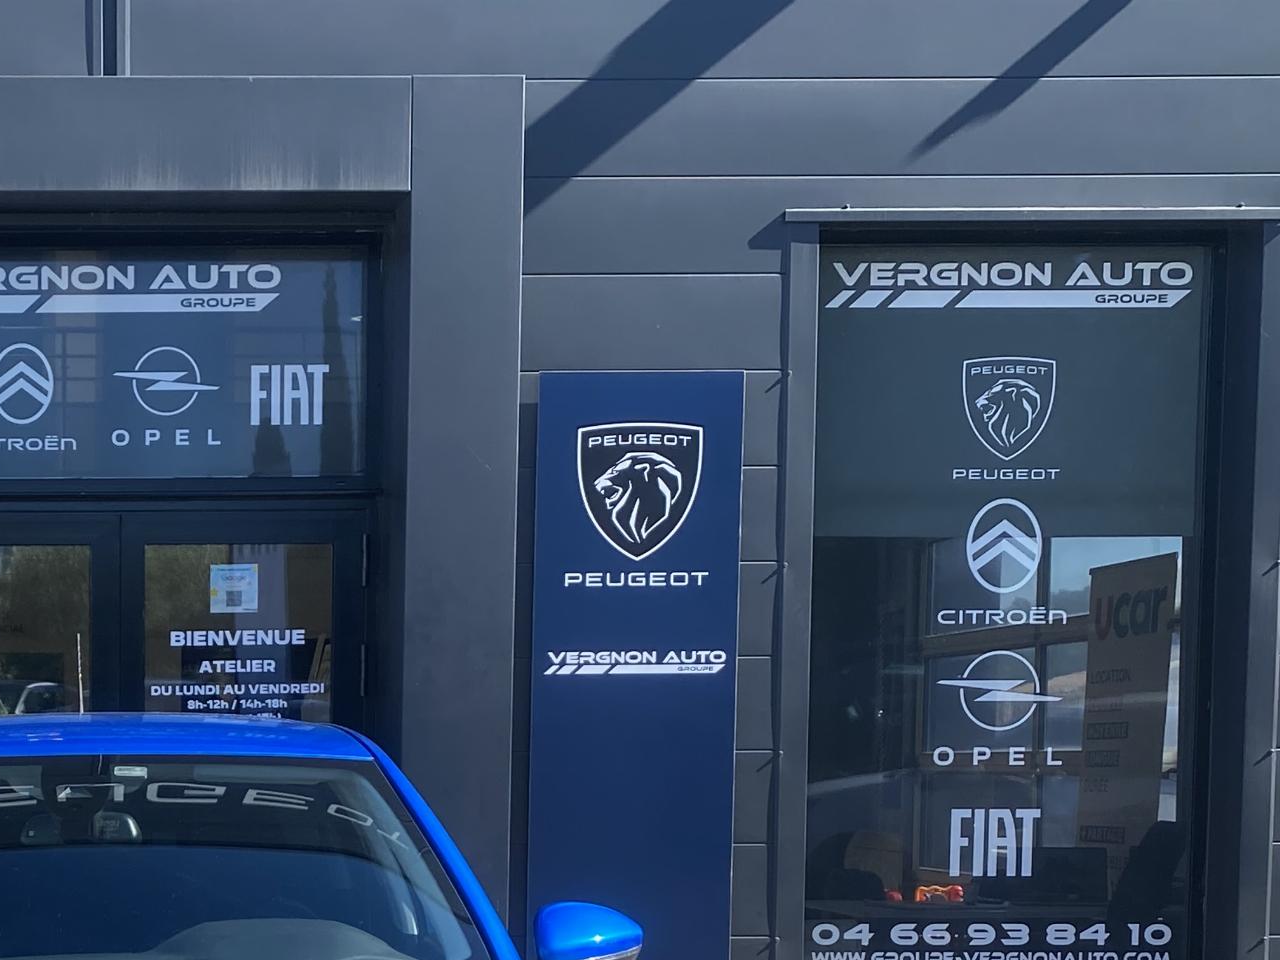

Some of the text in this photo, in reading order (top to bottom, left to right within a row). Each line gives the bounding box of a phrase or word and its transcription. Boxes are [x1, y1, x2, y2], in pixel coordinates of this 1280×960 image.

[149, 264, 282, 290] AUTO
[832, 262, 1194, 286] VERGNON AUTO
[180, 297, 257, 309] GROUPE
[1094, 293, 1169, 304] GROUPE
[970, 365, 1048, 376] PEUGEOT
[250, 363, 330, 426] FIAT
[111, 428, 222, 447] OPEL
[588, 434, 692, 448] PEUGEOT
[952, 469, 1061, 480] PEUGEOT
[564, 571, 709, 587] PEUGEOT
[937, 606, 1067, 625] CITROËN
[170, 629, 306, 647] BIENVENUE
[547, 650, 727, 664] VERGNON AUTO
[199, 659, 276, 673] ATELIER
[150, 683, 325, 696] DU LUNDI AU VENDREDI
[187, 700, 229, 710] 8h-12h
[239, 699, 288, 709] 14h-18h
[933, 746, 1062, 766] OPEL
[949, 808, 1041, 877] FIAT
[811, 923, 1172, 947] 04 66 93 84 10
